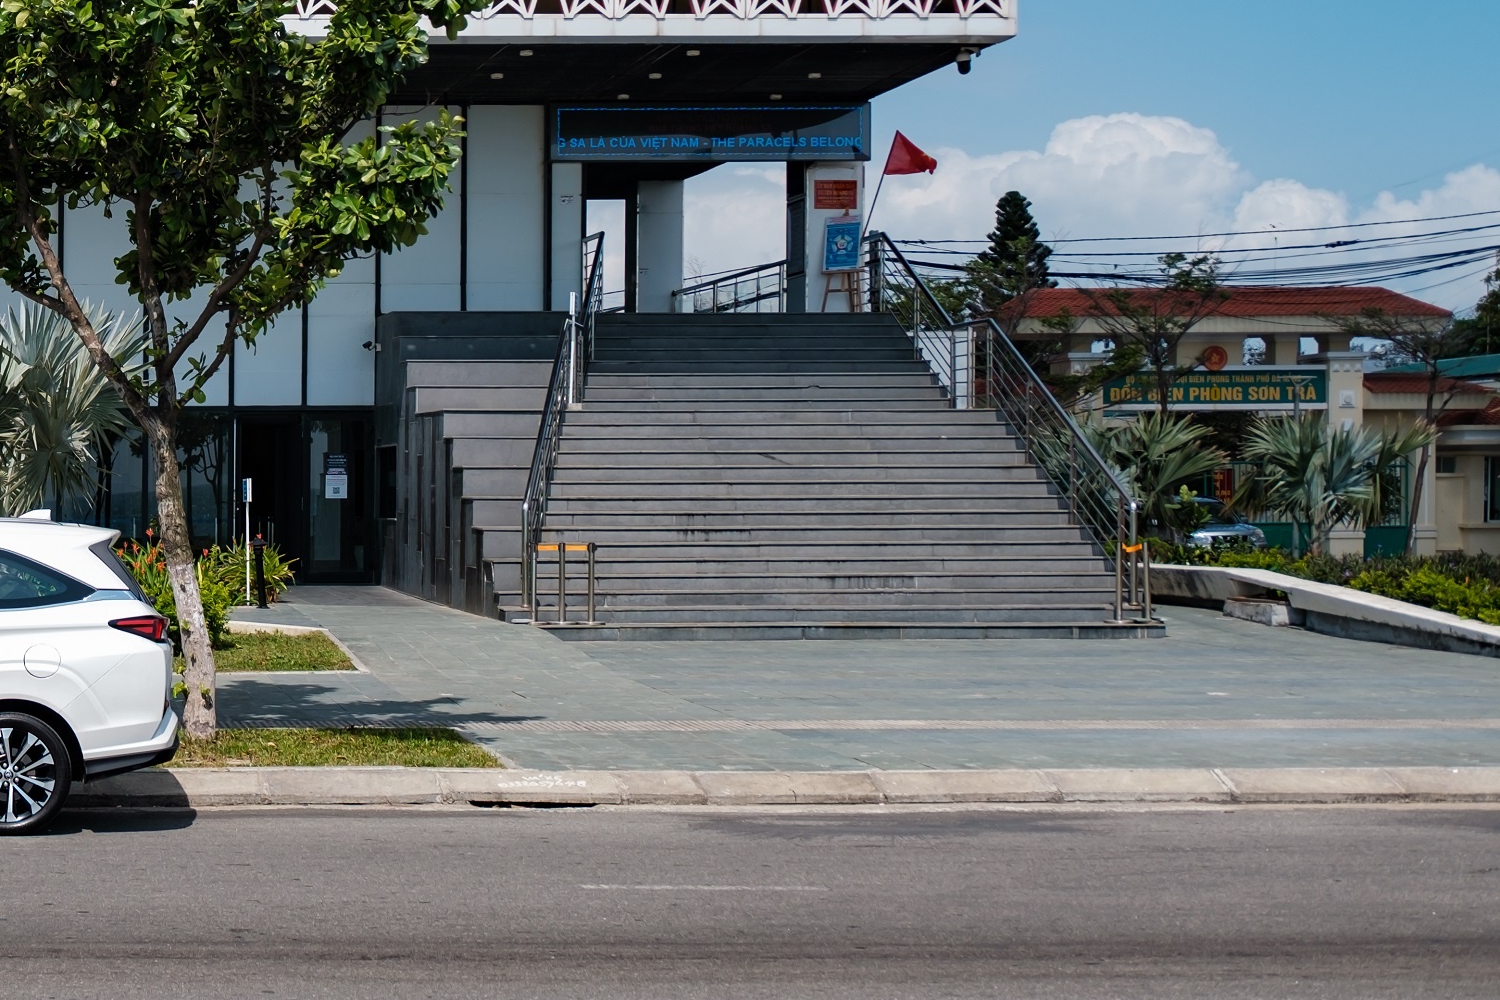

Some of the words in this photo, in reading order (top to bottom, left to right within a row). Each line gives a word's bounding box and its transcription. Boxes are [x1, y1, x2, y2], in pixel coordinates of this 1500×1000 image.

[569, 137, 586, 148] SA
[590, 135, 605, 148] LÀ
[609, 135, 636, 148] CỦA
[640, 137, 668, 150] VIỆT
[671, 137, 699, 148] NAM
[711, 137, 735, 148] THE
[738, 136, 807, 148] PARACELS
[1189, 383, 1243, 401] PHÒNG
[1248, 384, 1280, 401] SƠN
